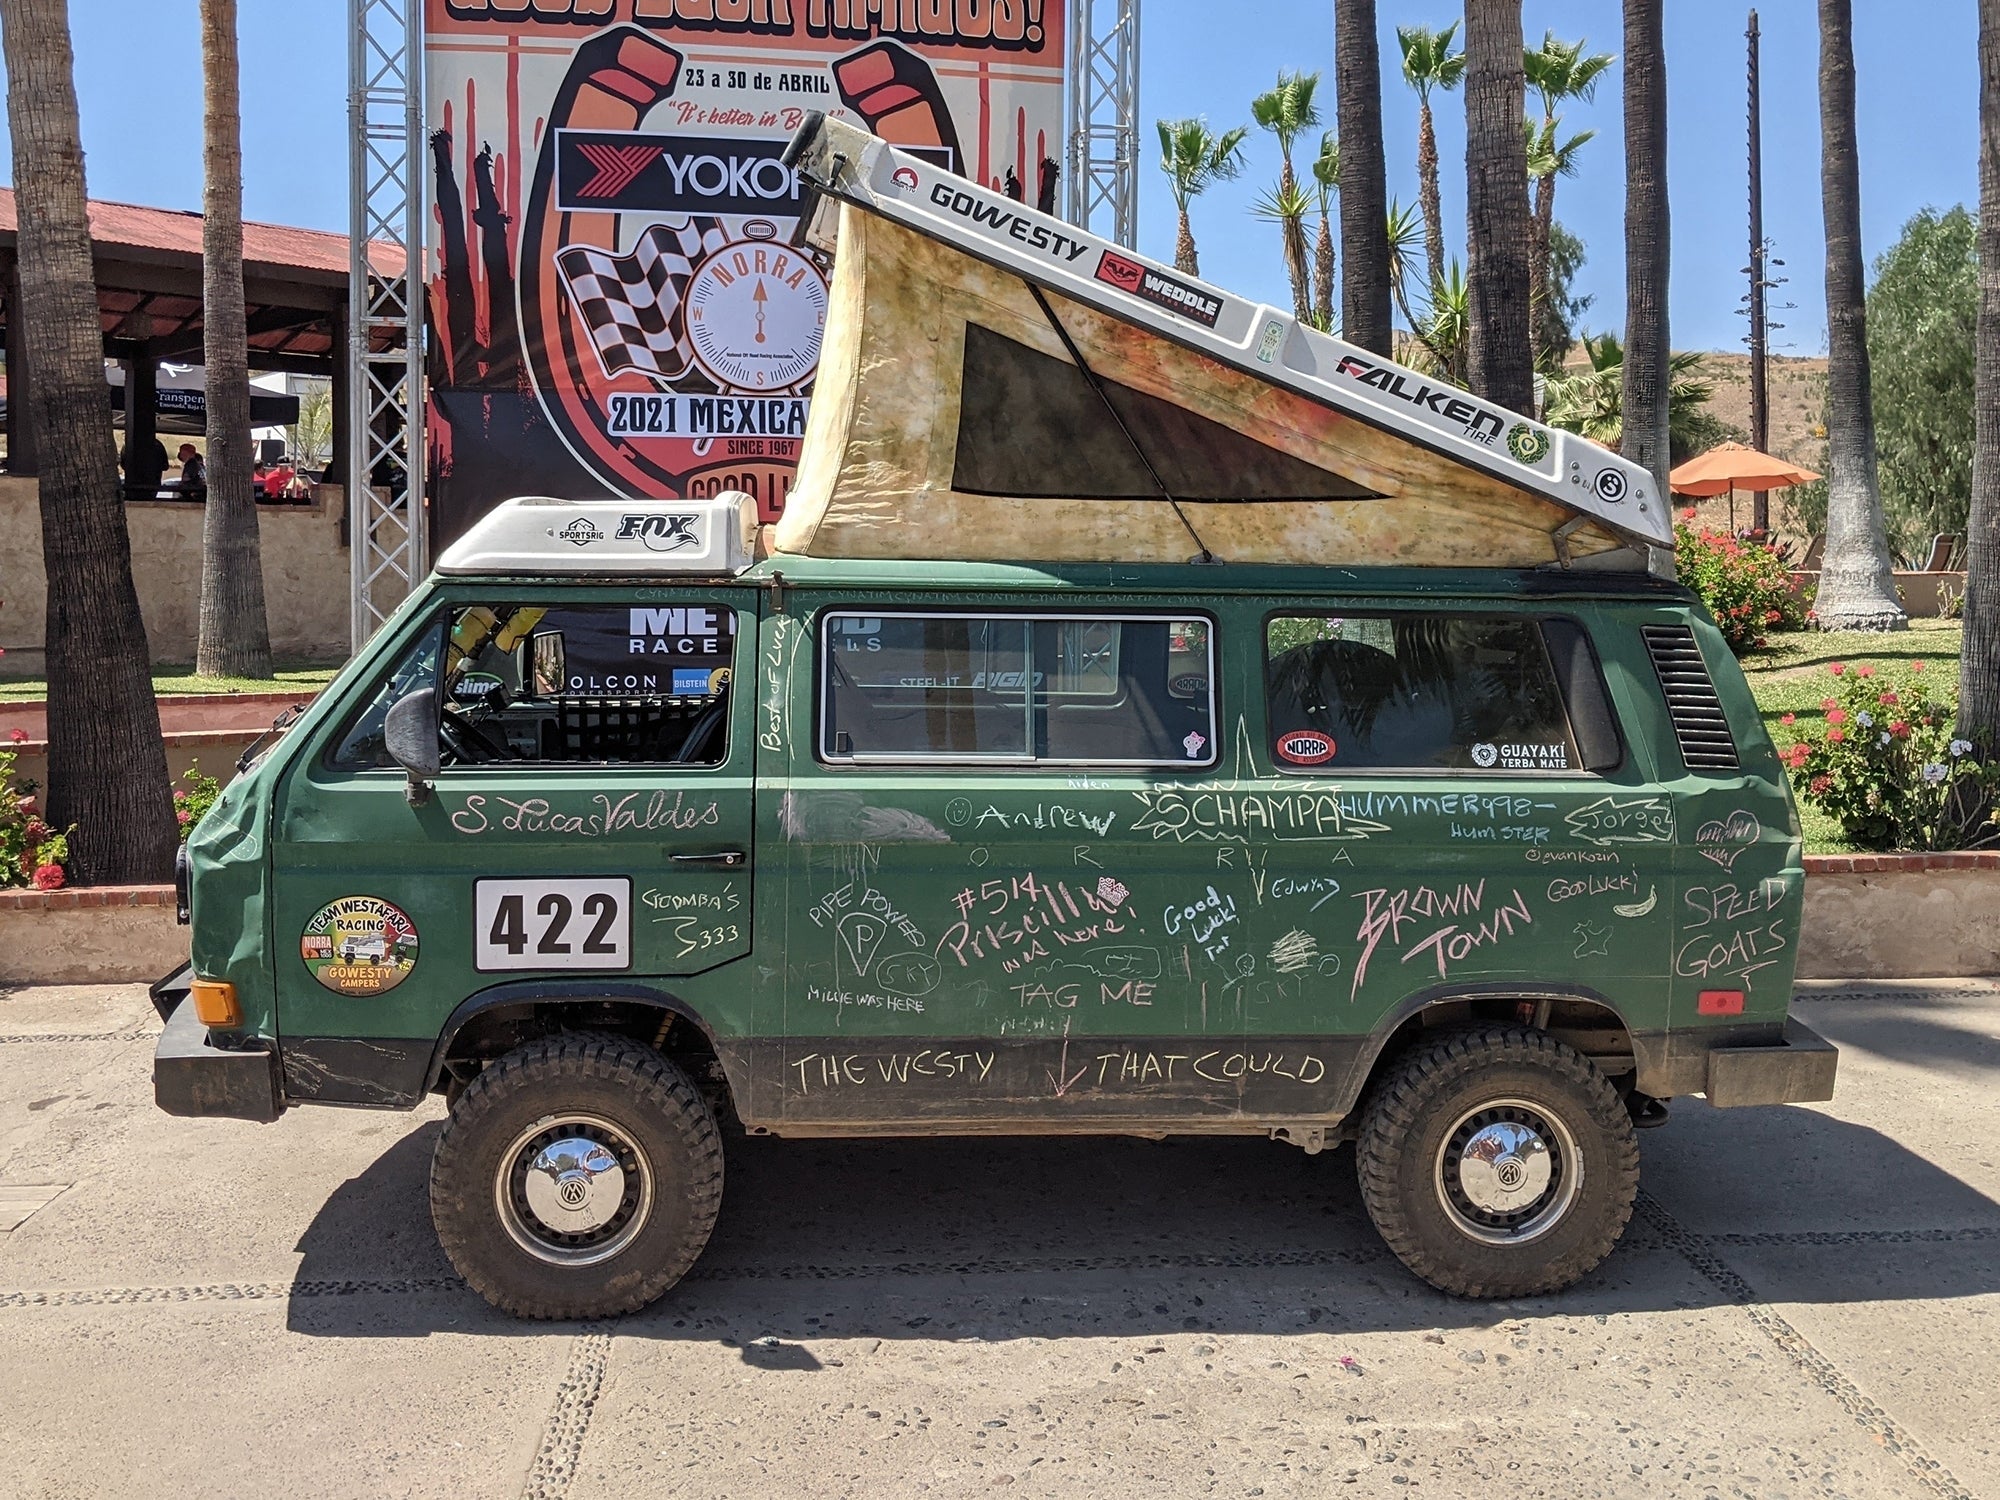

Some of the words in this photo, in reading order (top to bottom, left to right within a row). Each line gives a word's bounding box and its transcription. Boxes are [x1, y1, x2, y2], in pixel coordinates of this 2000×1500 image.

[686, 68, 704, 86] 23
[711, 74, 720, 88] a
[728, 71, 746, 88] 30
[753, 72, 772, 90] de
[778, 73, 830, 94] ABRIL
[707, 107, 755, 125] better
[758, 111, 777, 127] in
[930, 182, 1089, 262] GOWESTY
[710, 249, 807, 291] NORRA
[1142, 288, 1178, 307] RACING
[1144, 274, 1218, 316] WEDDLE
[159, 393, 205, 405] ranspen
[1335, 355, 1505, 438] FALKEN
[611, 397, 676, 433] 2021
[689, 398, 811, 435] MEXICA
[728, 440, 764, 455] SINCE
[768, 441, 794, 455] 1967
[1463, 425, 1497, 446] TIRE
[559, 531, 604, 540] SPORTSRIG
[615, 514, 699, 552] FOX
[629, 638, 718, 653] RACE
[570, 675, 656, 689] OLCON
[674, 678, 707, 688] BILSTEIN
[1286, 739, 1327, 755] NORRA
[1501, 758, 1535, 768] YERBA
[1540, 758, 1567, 769] MATE
[593, 789, 719, 835] Valdes
[308, 904, 342, 933] TEAM
[341, 899, 410, 934] WESTAFARI
[809, 884, 853, 927] PIPE
[1683, 879, 1786, 929] SPEED
[336, 919, 385, 931] RACING
[489, 892, 620, 956] 422
[1401, 888, 1532, 981] TOWN
[304, 935, 332, 949] NORRA
[1675, 919, 1786, 978] GOATS
[329, 967, 392, 979] GOWESTY
[340, 979, 380, 988] CAMPERS
[882, 962, 935, 987] SKY
[1009, 982, 1081, 1009] TAG
[1101, 980, 1157, 1006] ME
[791, 1053, 866, 1096] THE
[878, 1050, 995, 1084] WESTY
[1096, 1050, 1189, 1085] THAT
[1193, 1049, 1326, 1084] COULD
